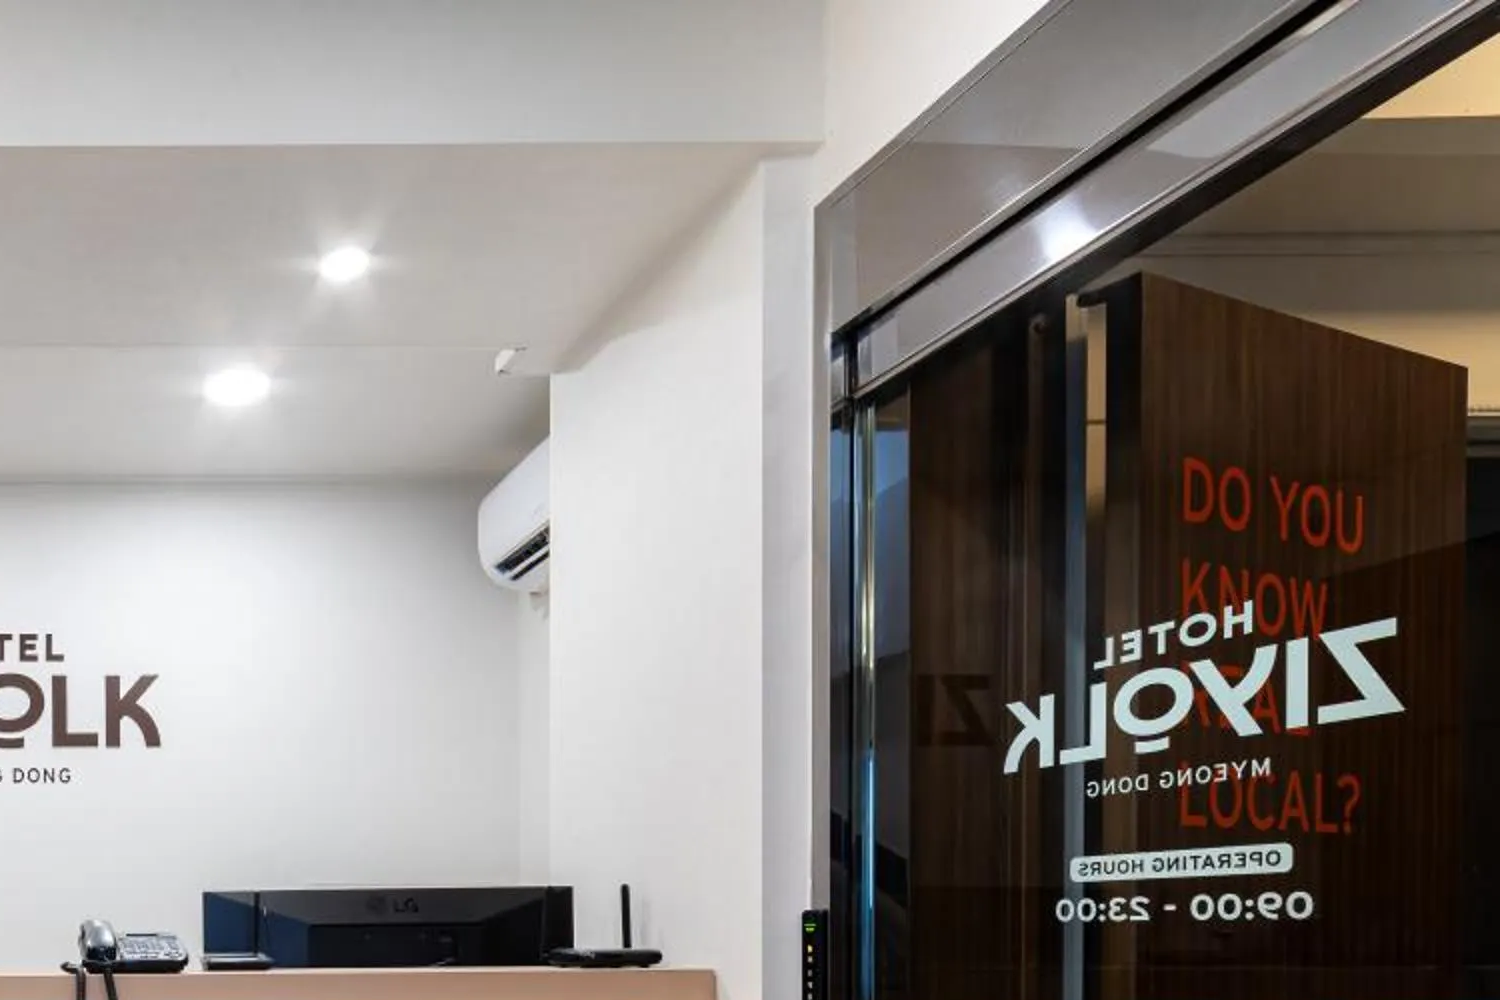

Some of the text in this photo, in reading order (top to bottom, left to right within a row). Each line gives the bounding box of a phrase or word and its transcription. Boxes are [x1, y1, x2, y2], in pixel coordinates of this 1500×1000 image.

[1182, 457, 1365, 553] DO YOU
[1181, 559, 1329, 640] KNOW
[12, 767, 72, 785] DONG
[1181, 760, 1362, 834] LOCAL?
